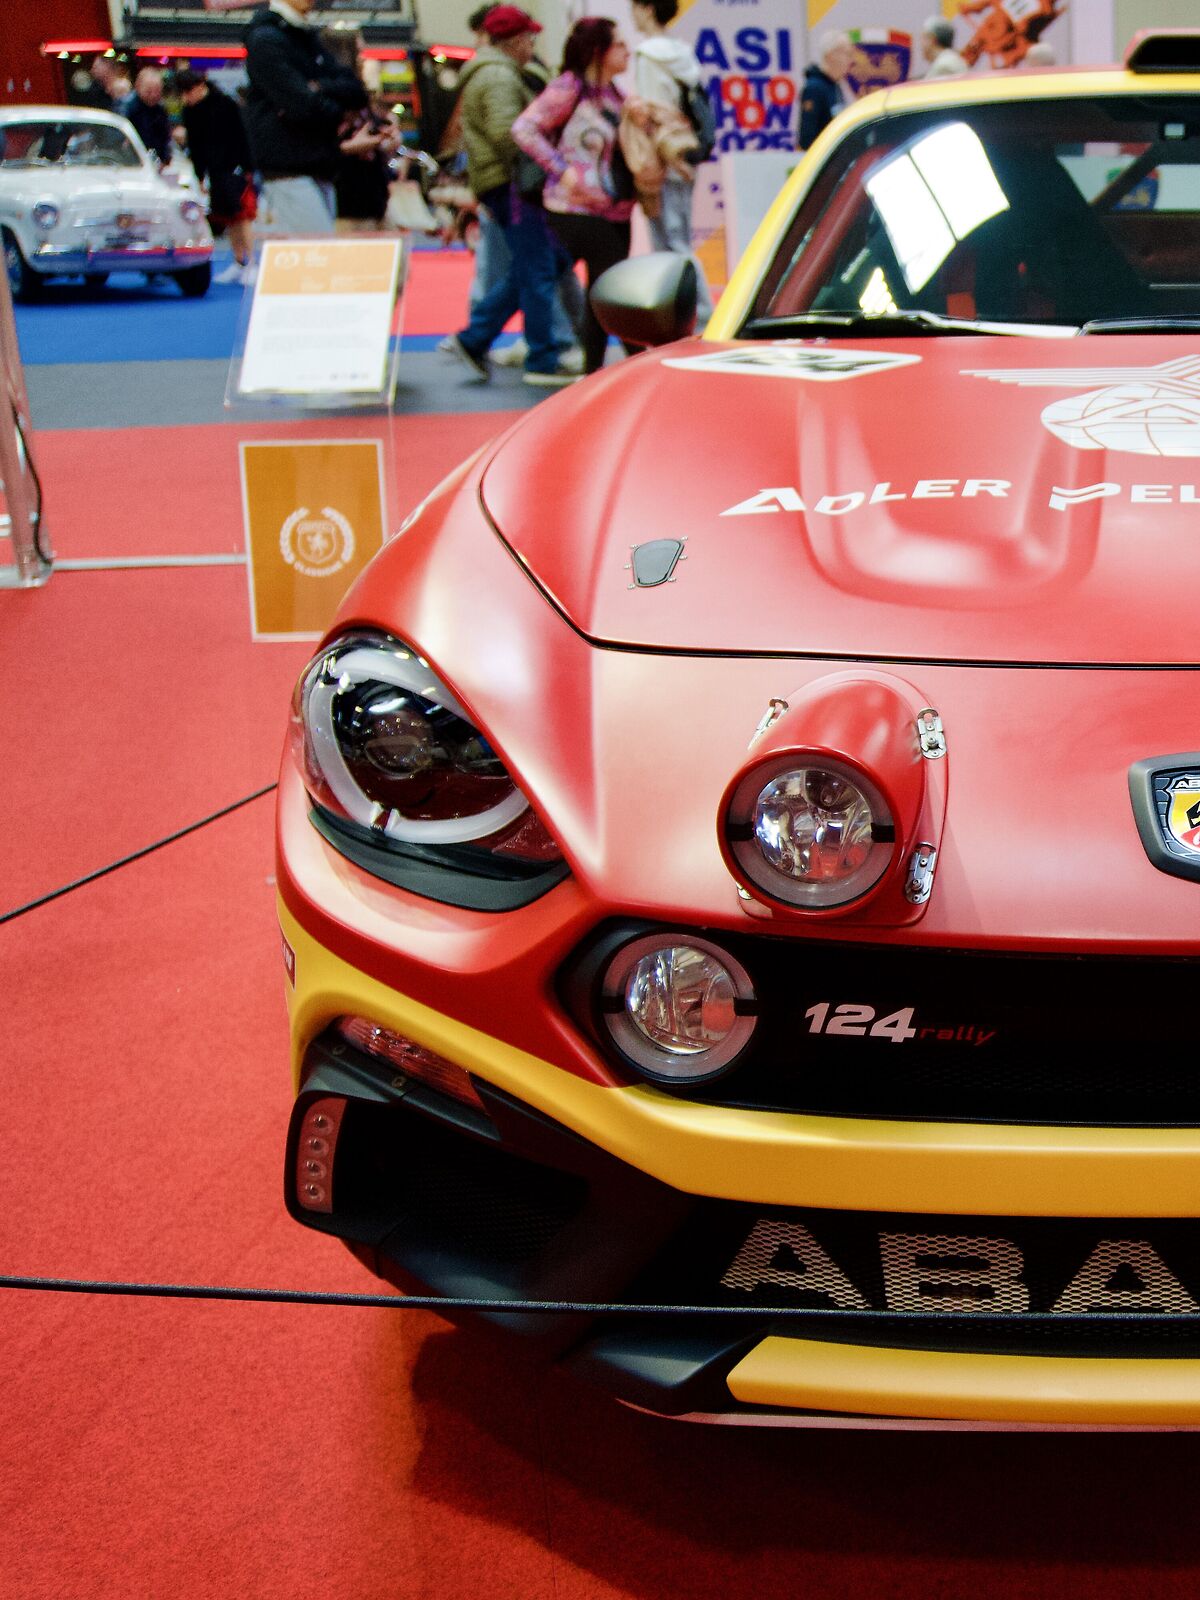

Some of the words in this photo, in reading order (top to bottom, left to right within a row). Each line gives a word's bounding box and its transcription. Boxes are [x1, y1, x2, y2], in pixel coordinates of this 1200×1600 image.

[695, 27, 791, 72] ASI
[714, 101, 794, 130] HOW
[710, 131, 794, 158] 025
[719, 479, 1013, 516] ADLER
[804, 1002, 917, 1043] 124
[919, 1025, 996, 1046] rally
